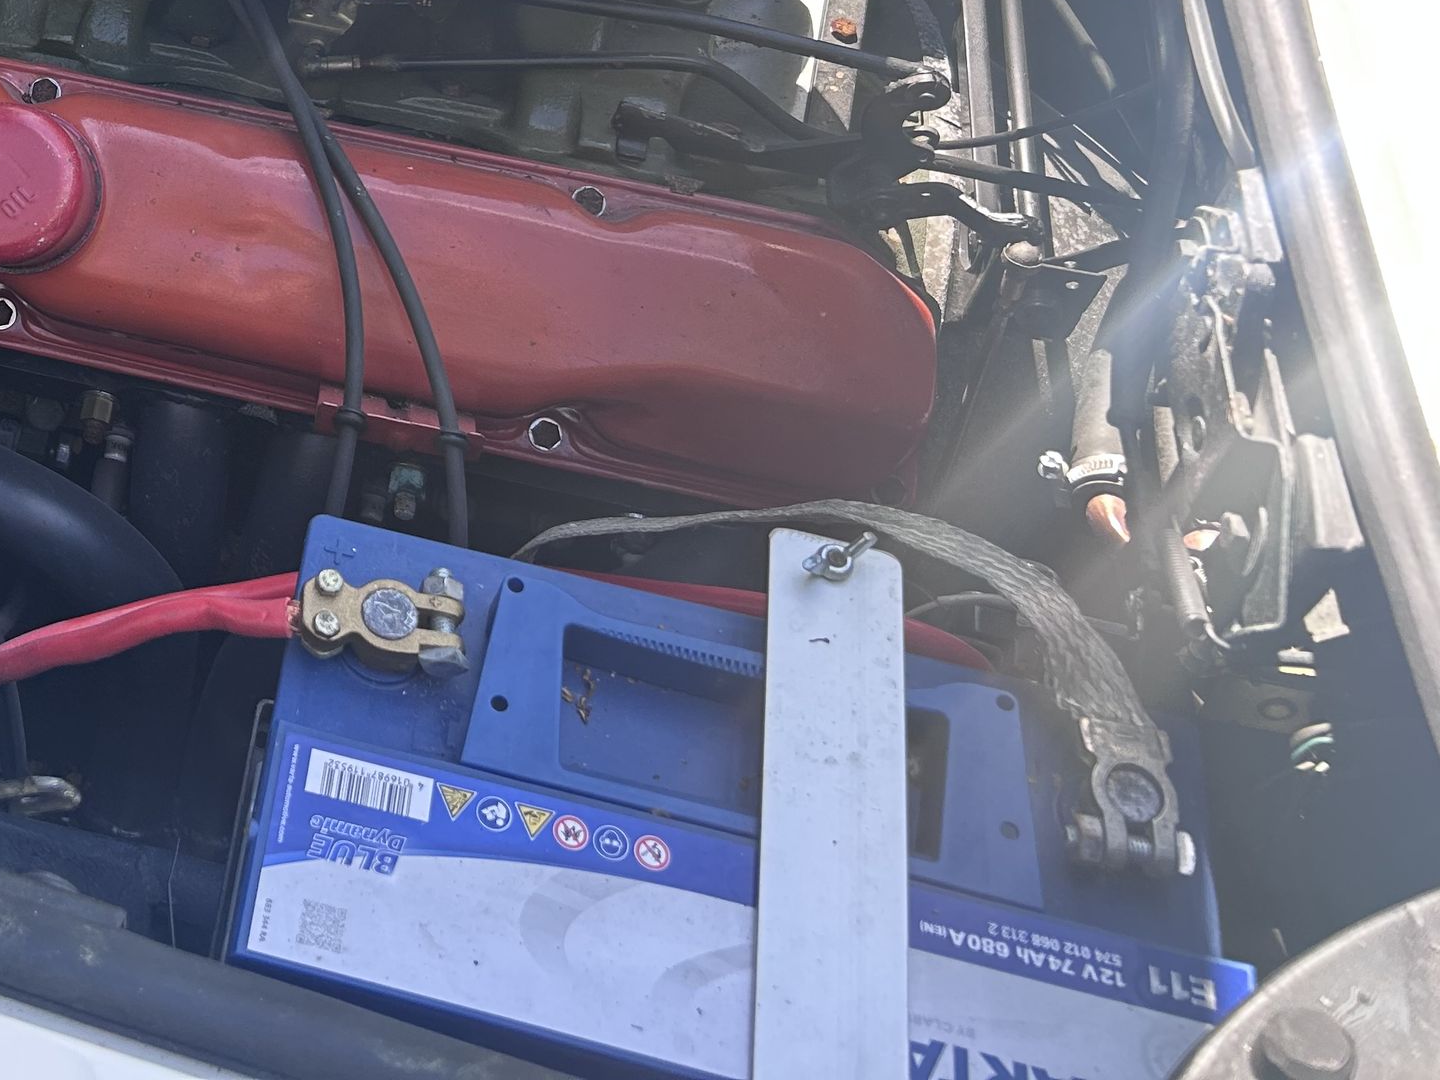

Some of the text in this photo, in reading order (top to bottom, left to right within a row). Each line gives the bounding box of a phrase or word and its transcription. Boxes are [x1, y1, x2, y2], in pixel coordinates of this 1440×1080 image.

[0, 185, 37, 219] OIL
[309, 813, 408, 853] Dynamic
[307, 832, 402, 876] BLUE
[986, 921, 1000, 936] 2
[1016, 945, 1076, 976] 74Ah
[1081, 963, 1127, 988] 12V
[1148, 964, 1218, 1011] E11
[908, 1012, 955, 1034] CLAR
